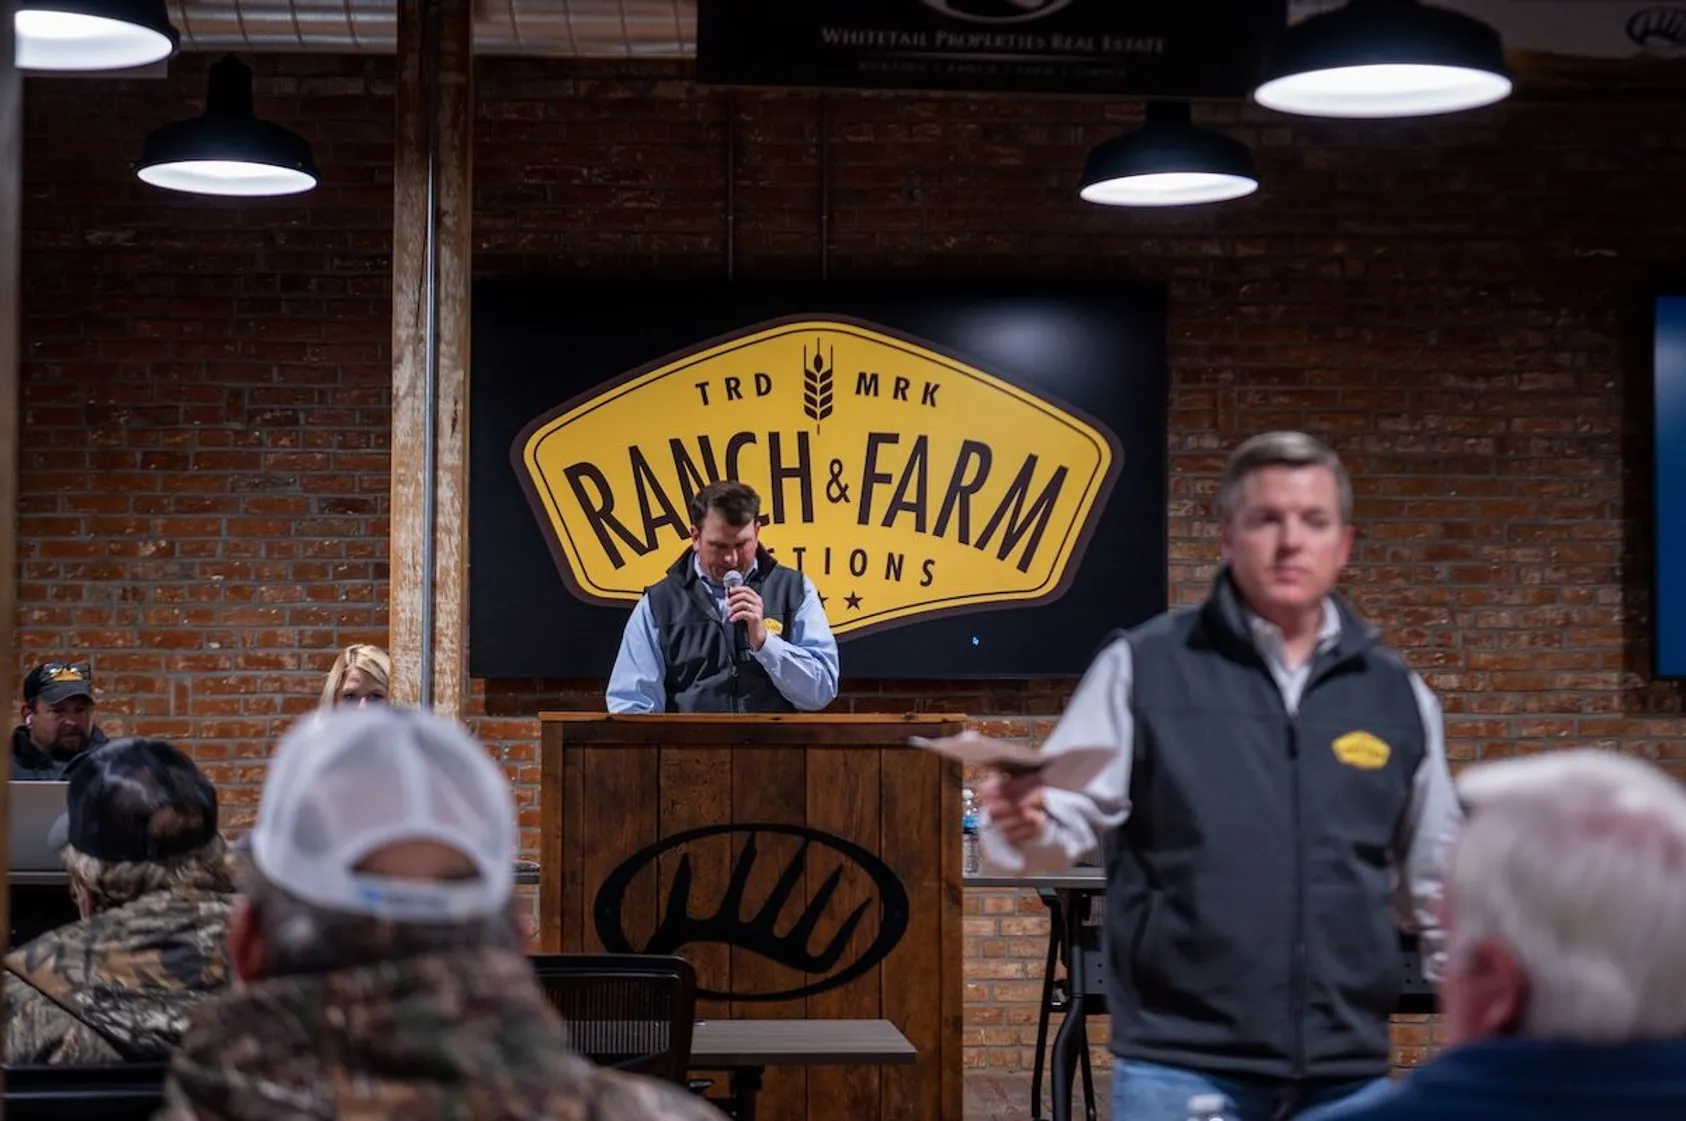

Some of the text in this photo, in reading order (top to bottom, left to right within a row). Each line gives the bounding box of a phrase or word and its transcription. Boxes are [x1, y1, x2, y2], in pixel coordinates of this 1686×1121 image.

[695, 371, 941, 407] TRD MRK
[563, 431, 1069, 574] RANCH & FARM
[768, 547, 936, 587] TIONS
